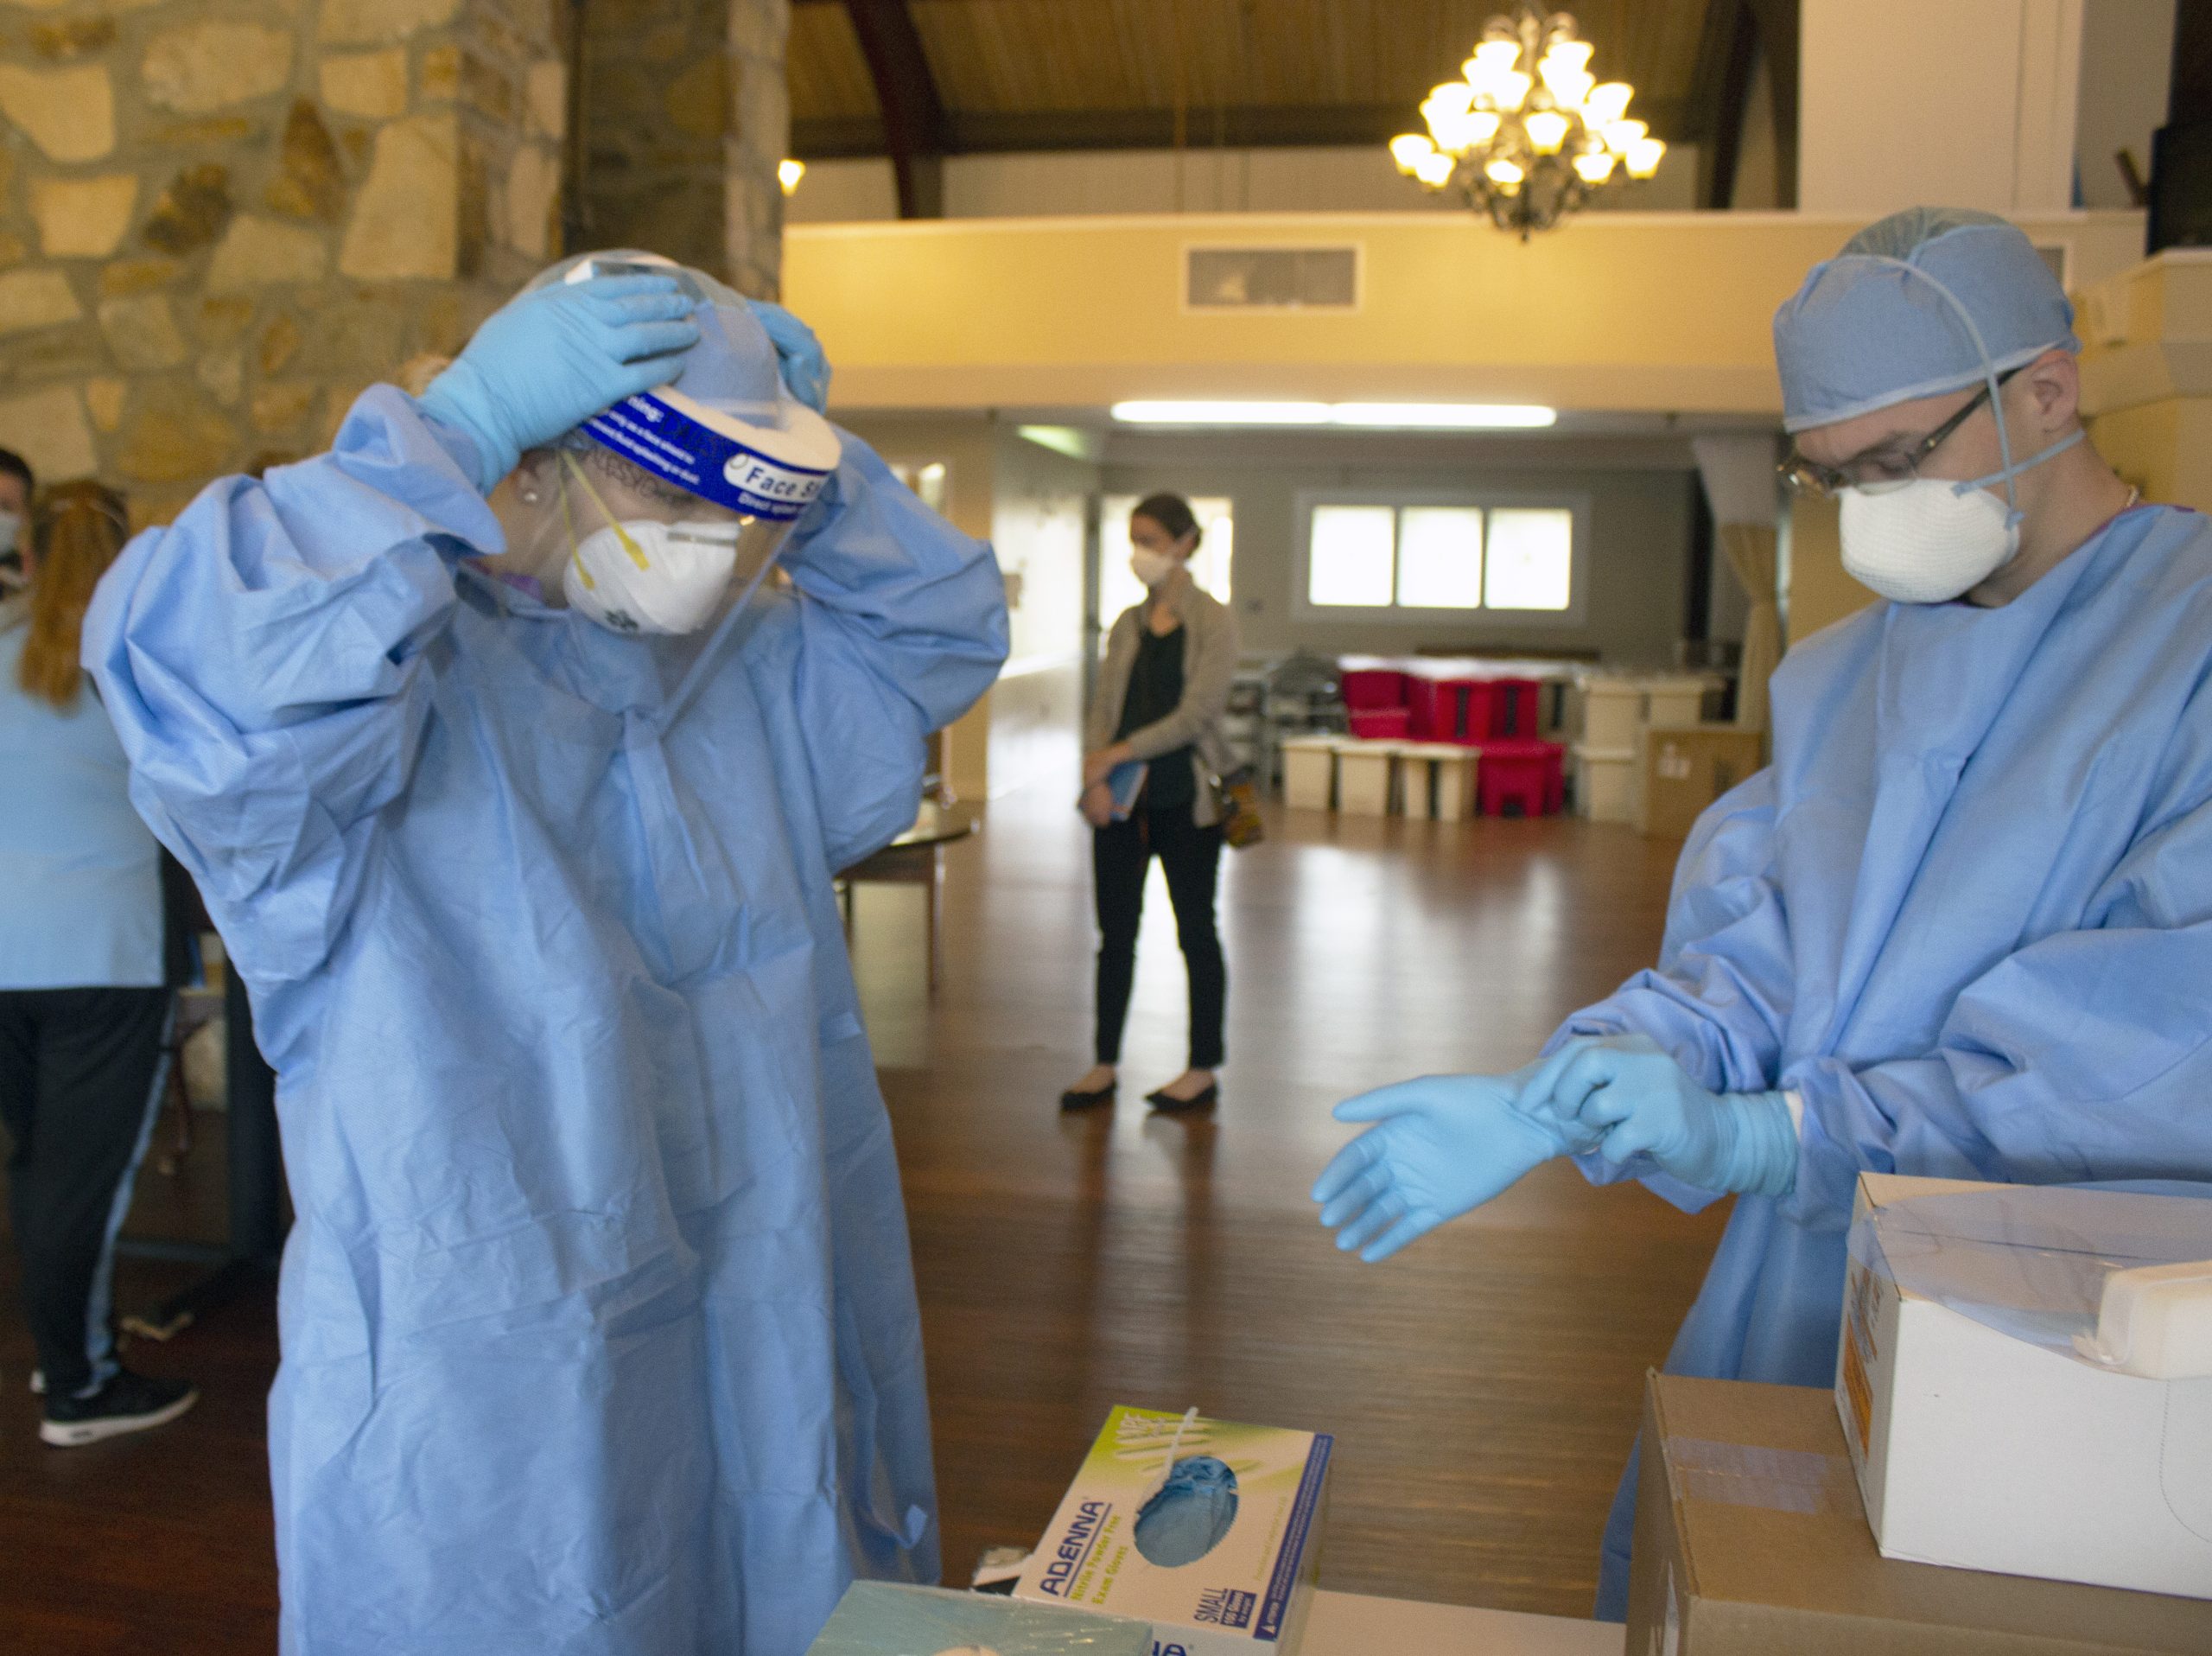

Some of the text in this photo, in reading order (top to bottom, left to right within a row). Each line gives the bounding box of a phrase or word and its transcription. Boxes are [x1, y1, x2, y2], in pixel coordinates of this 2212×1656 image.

[746, 465, 797, 496] Face
[1039, 1501, 1105, 1596] ADENNA
[1071, 1513, 1121, 1601] Nitrile Powder Free
[1091, 1545, 1128, 1605] Exam Gloves
[1193, 1588, 1228, 1624] SMALL
